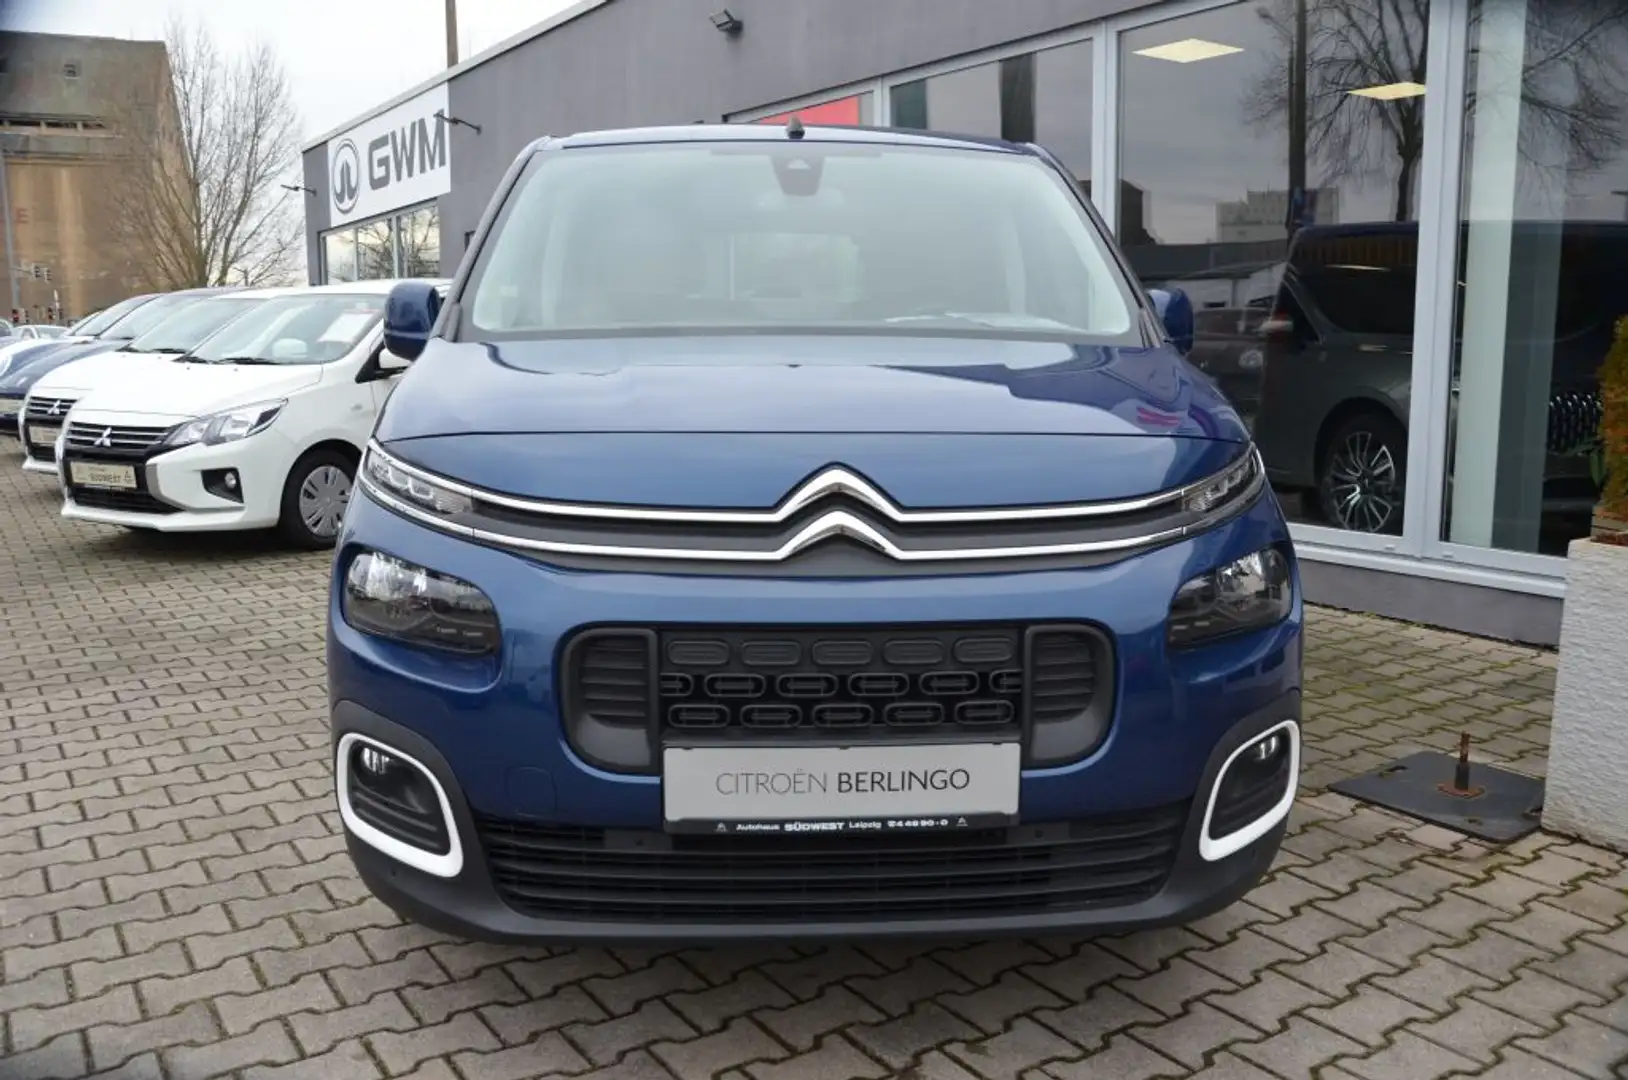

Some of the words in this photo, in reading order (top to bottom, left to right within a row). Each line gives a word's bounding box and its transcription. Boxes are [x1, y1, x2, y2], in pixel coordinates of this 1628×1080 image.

[368, 108, 447, 191] GWM
[715, 767, 827, 796] CITROËN
[837, 768, 970, 793] BERLINGO
[784, 821, 845, 832] SÜDWEST
[848, 820, 882, 830] Leipzig
